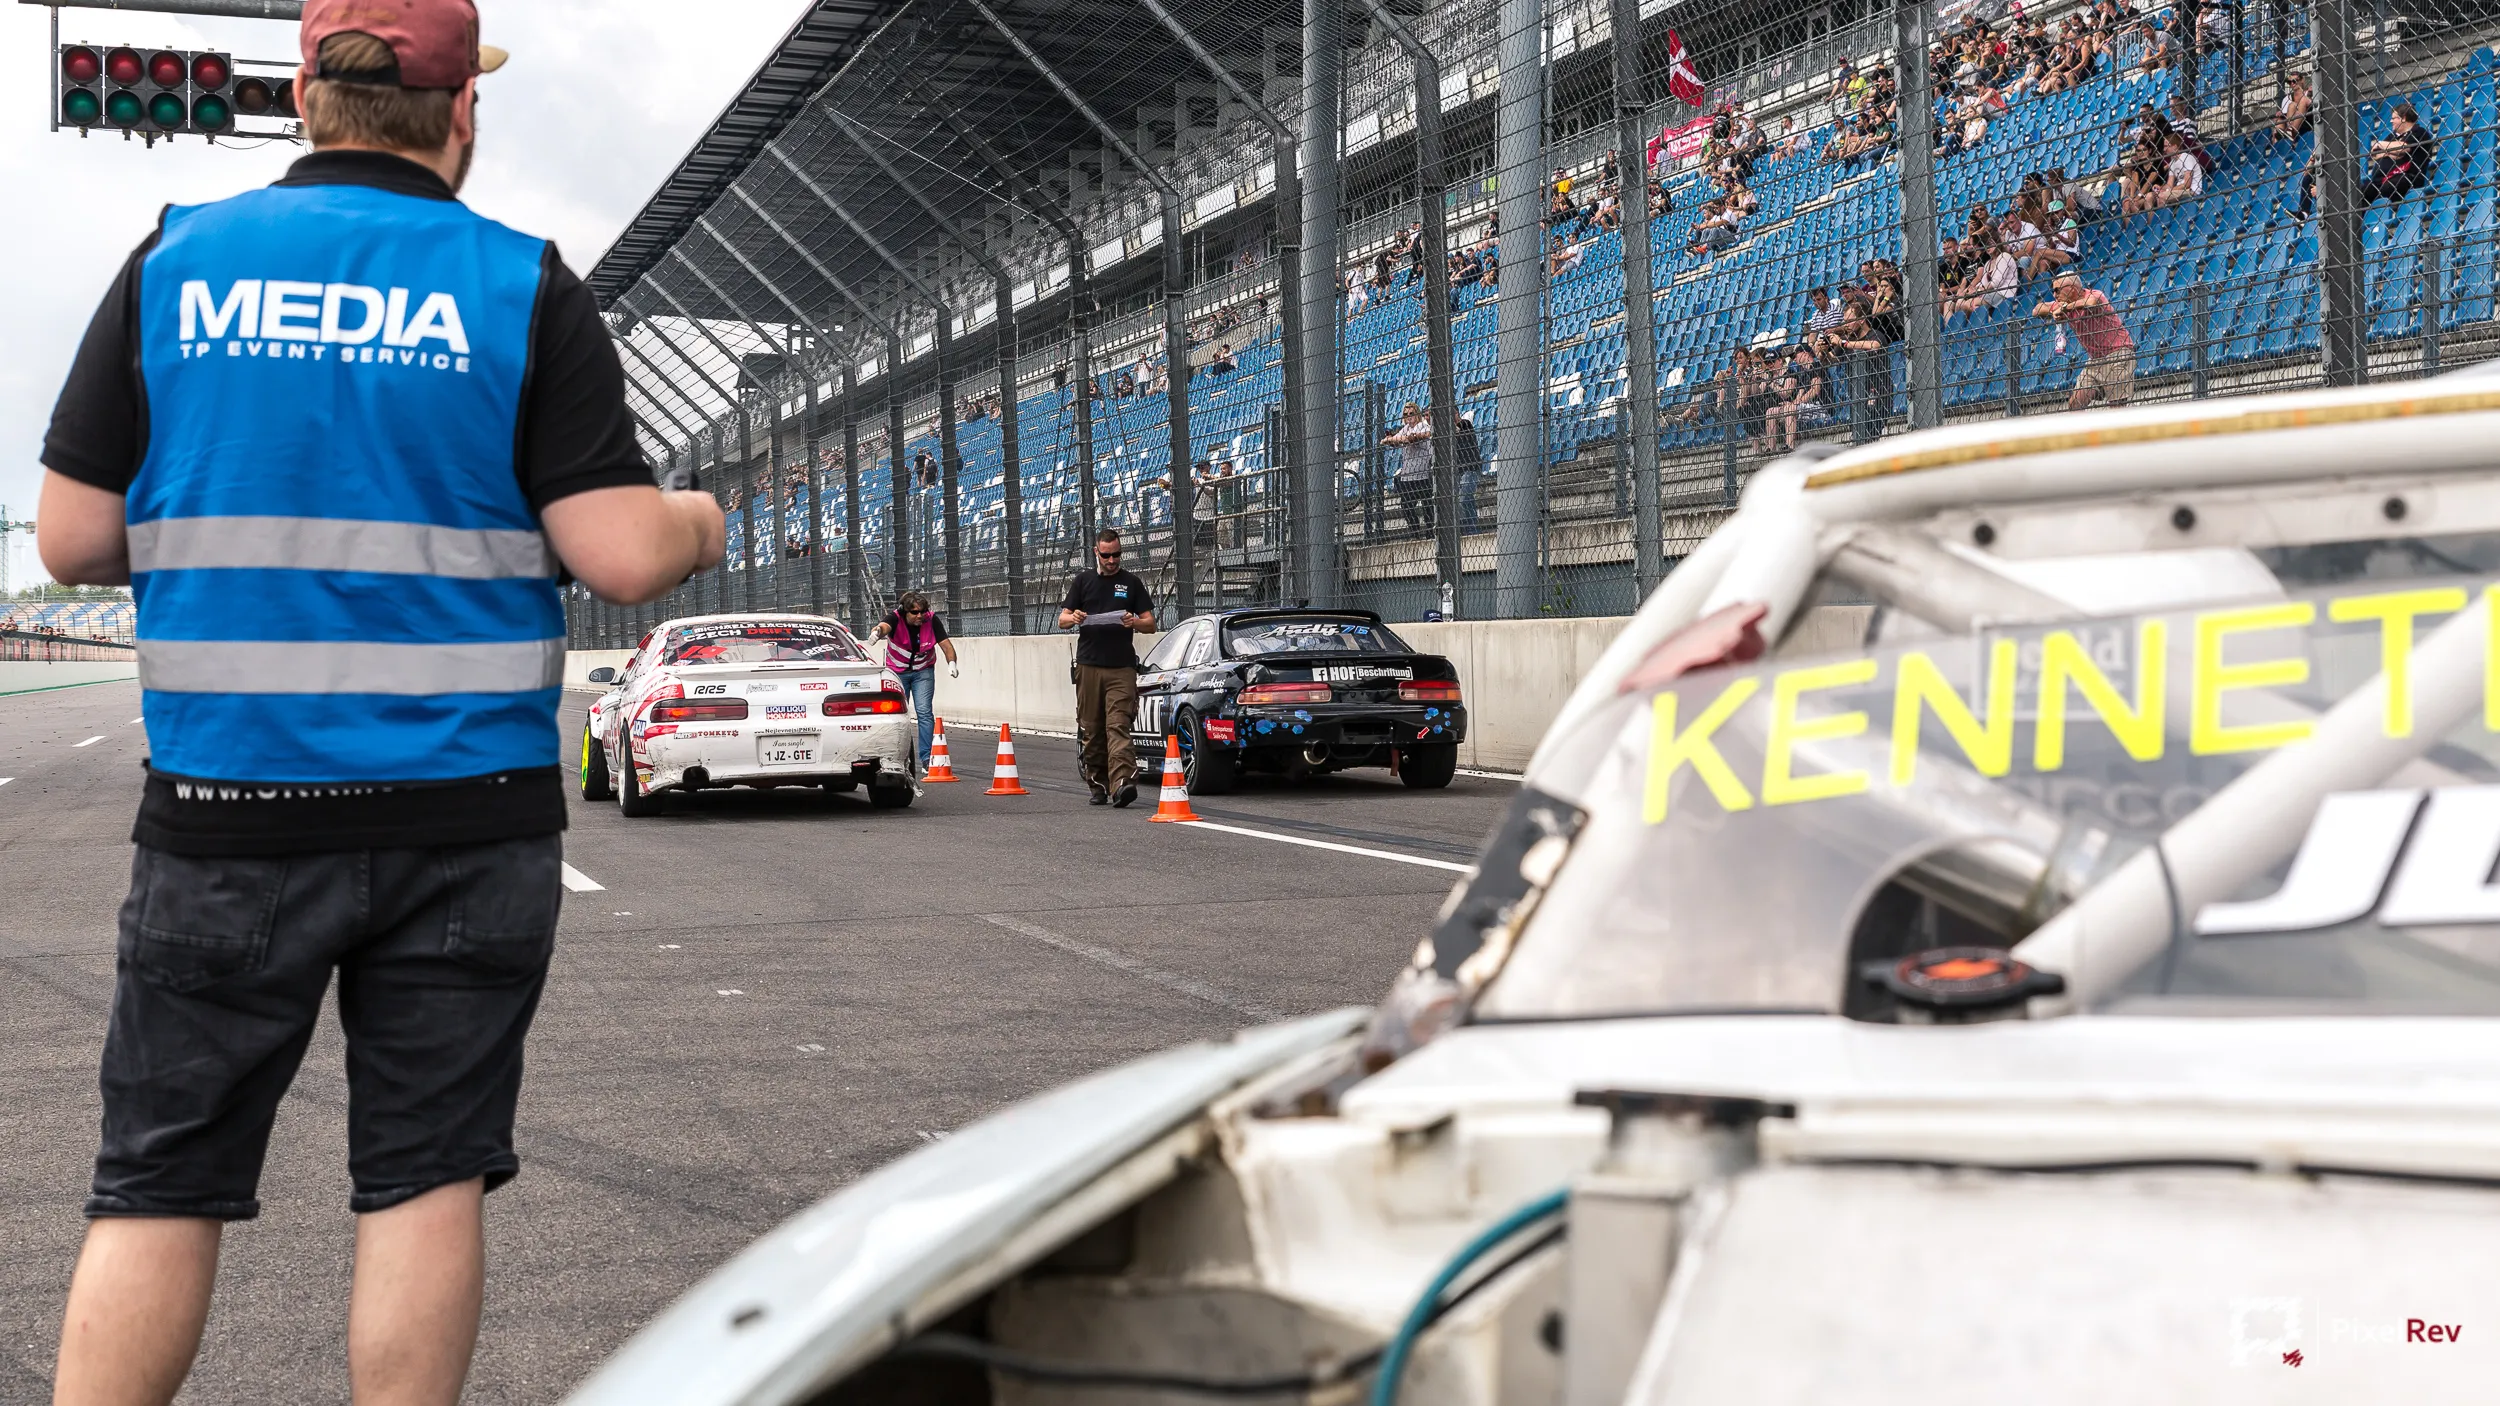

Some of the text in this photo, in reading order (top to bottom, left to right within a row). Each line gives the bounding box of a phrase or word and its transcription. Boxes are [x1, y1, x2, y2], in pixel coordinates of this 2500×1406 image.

[179, 279, 470, 354] MEDIA
[180, 341, 471, 374] TP EVENT SERVICE
[694, 623, 756, 633] MICHAELA
[1254, 623, 1340, 640] Andy
[684, 629, 741, 642] CZECH
[798, 628, 836, 639] GIRL
[802, 644, 834, 657] RRS
[1329, 666, 1356, 681] HOF
[693, 685, 727, 695] RRS
[883, 680, 902, 692] RRS
[787, 738, 805, 748] single
[1133, 739, 1163, 747] GINEERING
[774, 751, 786, 761] JZ
[793, 750, 812, 761] GTE
